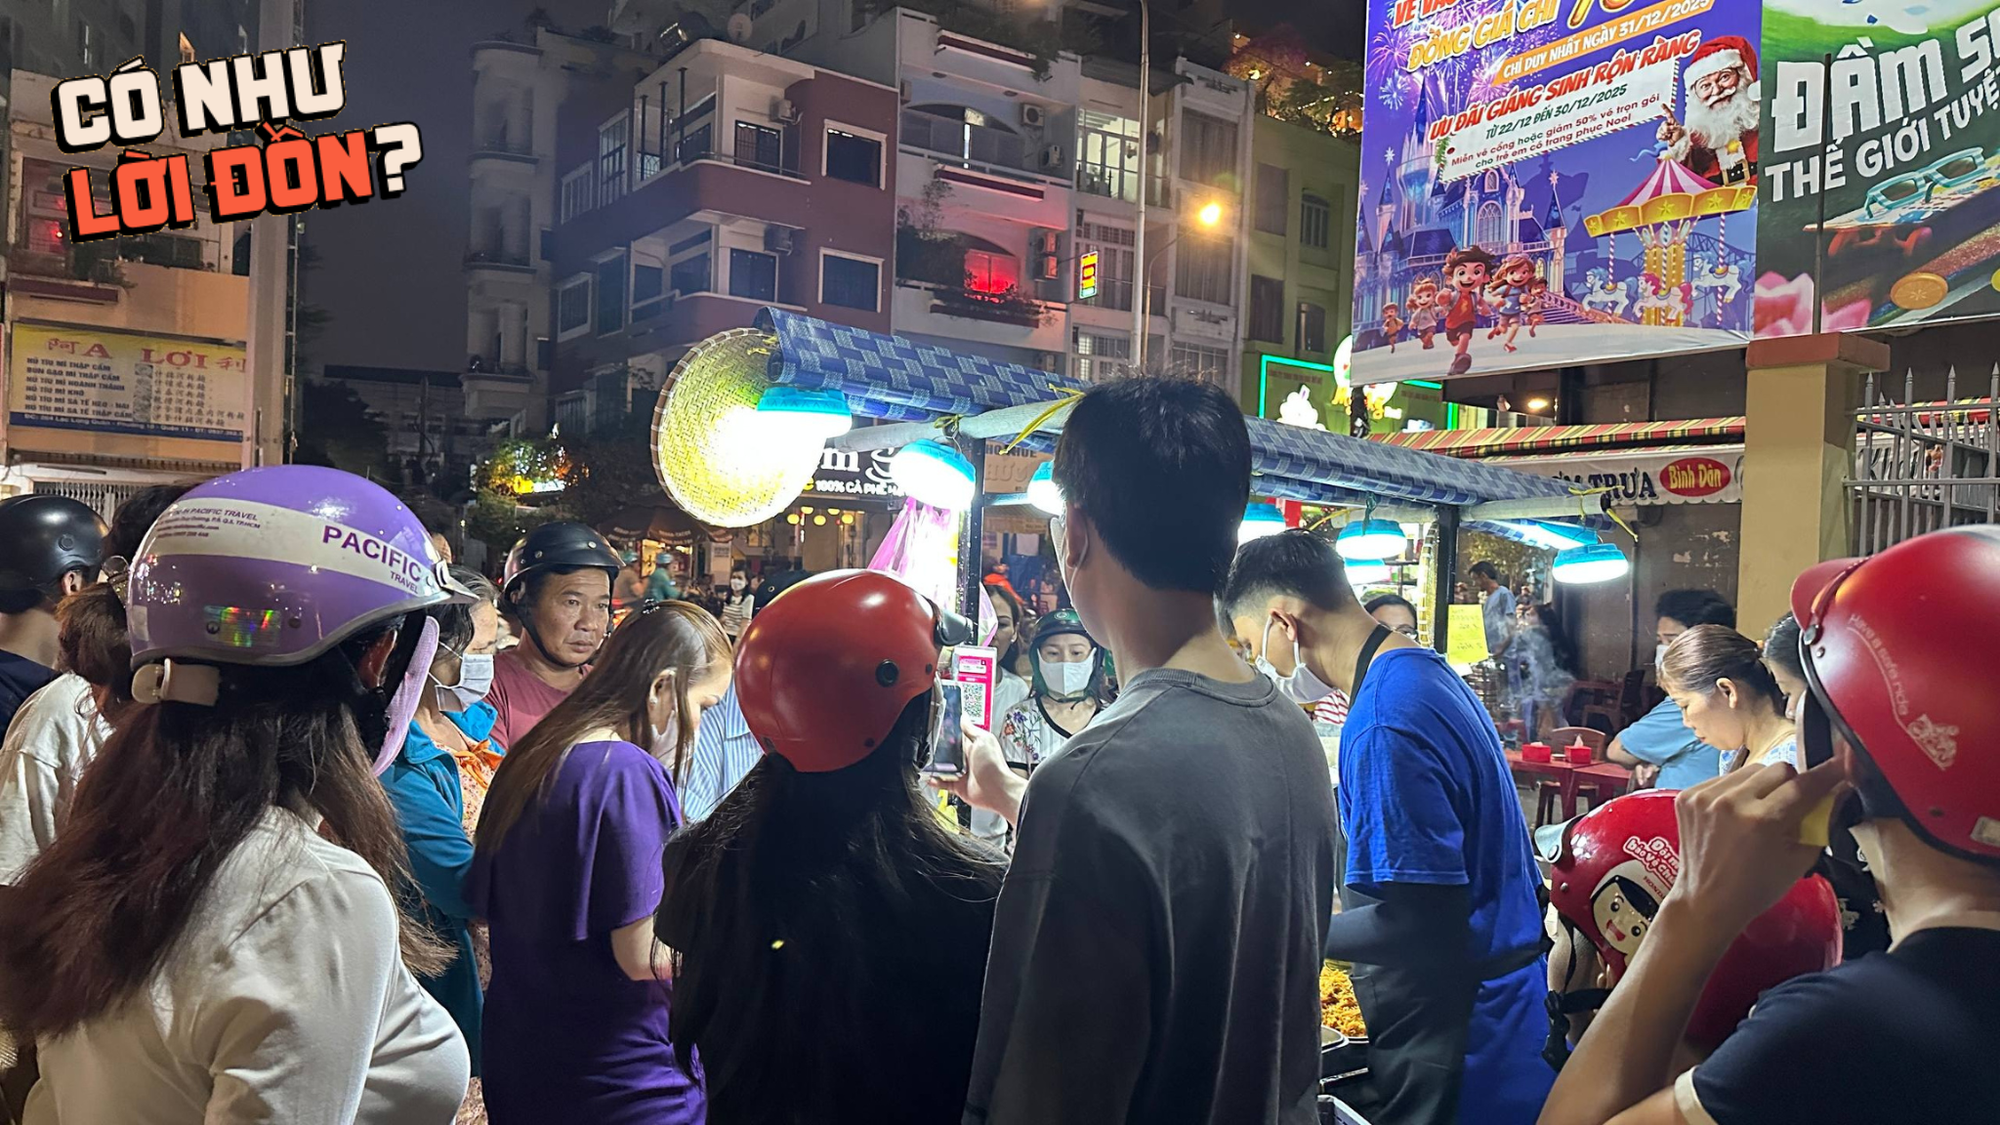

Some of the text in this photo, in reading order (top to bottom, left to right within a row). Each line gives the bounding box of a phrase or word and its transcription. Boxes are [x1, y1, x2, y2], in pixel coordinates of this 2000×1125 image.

[1408, 27, 1471, 71] ĐỒNG
[1474, 3, 1514, 48] GIÁ
[1504, 58, 1523, 79] CHỈ
[1524, 54, 1547, 72] DUY
[1549, 34, 1581, 63] NHẤT
[1583, 26, 1618, 51] NGÀY
[1618, 0, 1709, 37] 31/12/2025
[1455, 103, 1484, 132] ĐÃI
[1486, 86, 1543, 121] GIÁNG
[1545, 68, 1591, 101] SINH
[1592, 50, 1639, 85] RỘN
[1639, 31, 1701, 69] RÀNG
[1771, 36, 1948, 153] ĐẦM
[1486, 83, 1628, 139] TỪ 22/12 ĐẾN 30/12/2025
[1518, 132, 1543, 145] hoặc
[1546, 122, 1572, 138] giảm
[1576, 114, 1597, 127] 50%
[1616, 101, 1638, 114] trọn
[1641, 93, 1660, 108] gói
[1764, 65, 2000, 203] THẾ GIỚI TUYỆ
[1475, 157, 1493, 168] cho
[1511, 147, 1527, 157] em
[1529, 140, 1543, 151] có
[1546, 132, 1573, 147] trang
[1575, 123, 1603, 139] phục
[1606, 113, 1631, 128] Noel
[82, 343, 112, 359] A
[141, 347, 208, 370] LỢI
[815, 479, 846, 493] 100%
[1668, 464, 1695, 489] Bình
[1698, 463, 1722, 488] Dân
[224, 509, 258, 521] TRAVEL
[322, 525, 421, 582] PACIFIC
[390, 570, 419, 595] TRAVEL
